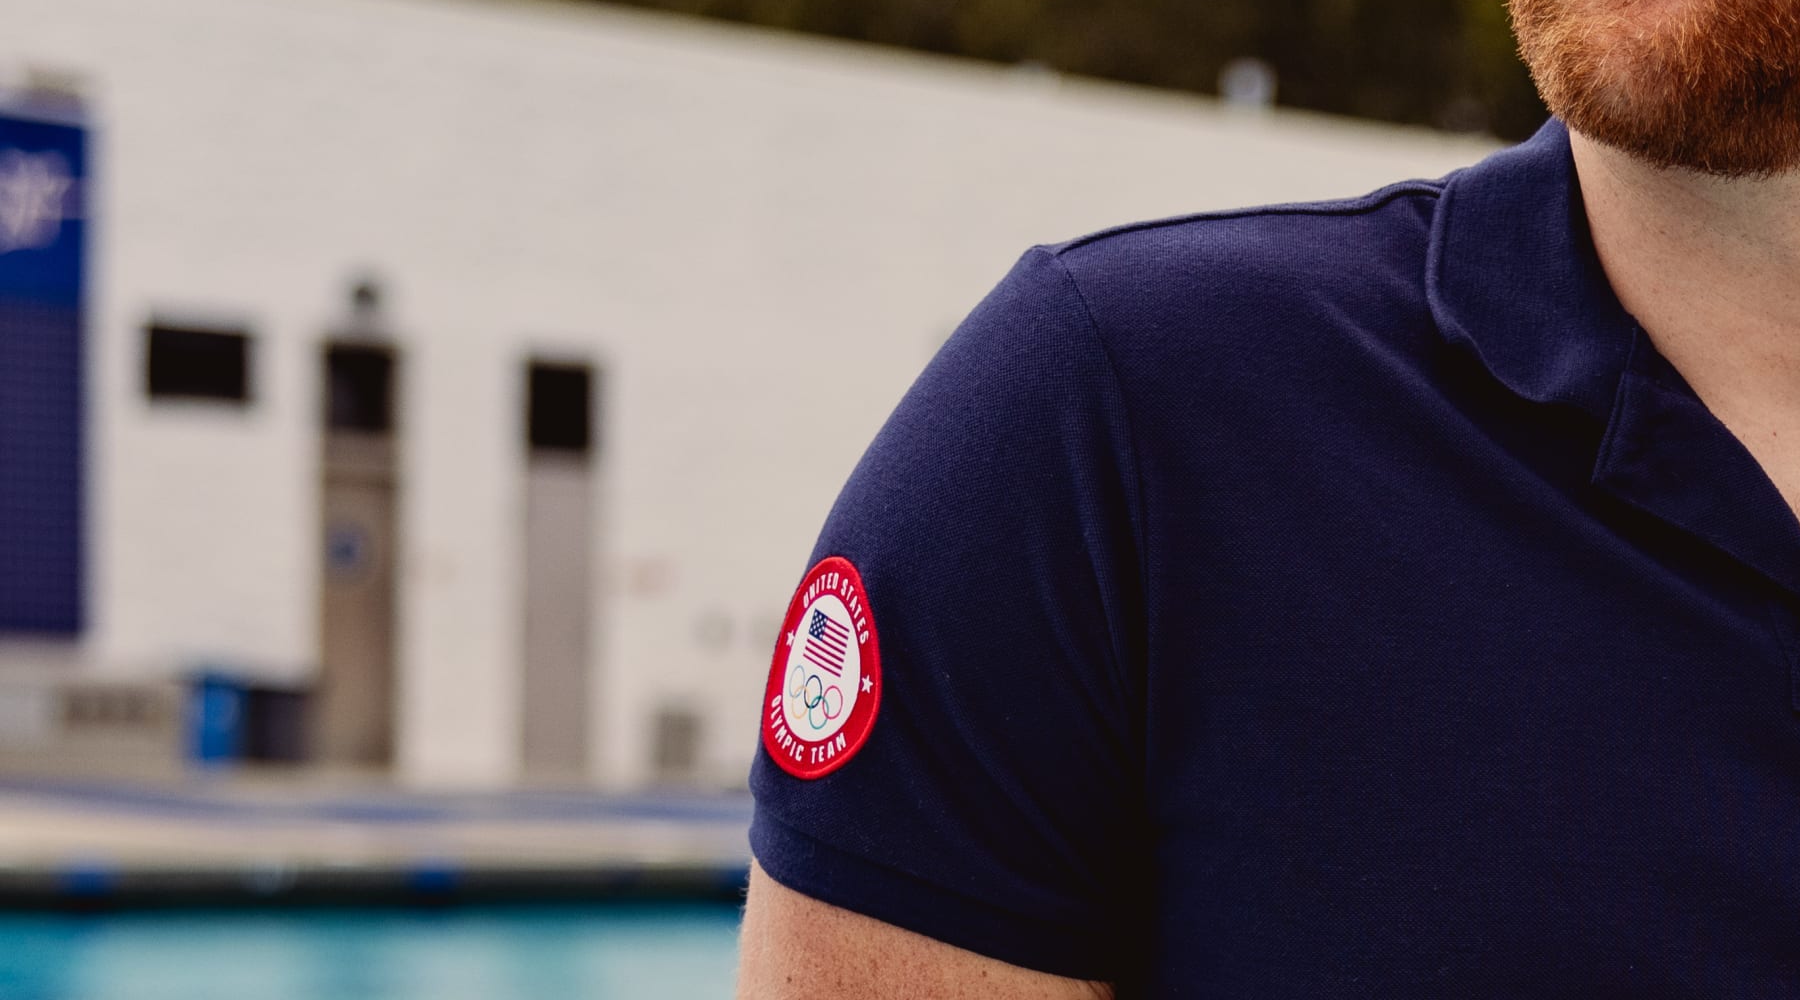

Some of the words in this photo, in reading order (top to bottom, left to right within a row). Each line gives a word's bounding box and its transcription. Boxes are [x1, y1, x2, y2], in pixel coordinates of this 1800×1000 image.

[803, 572, 839, 608] UNITED
[841, 578, 869, 646] STATES
[771, 694, 804, 762] OLYMPIC
[810, 732, 847, 764] TEAM
